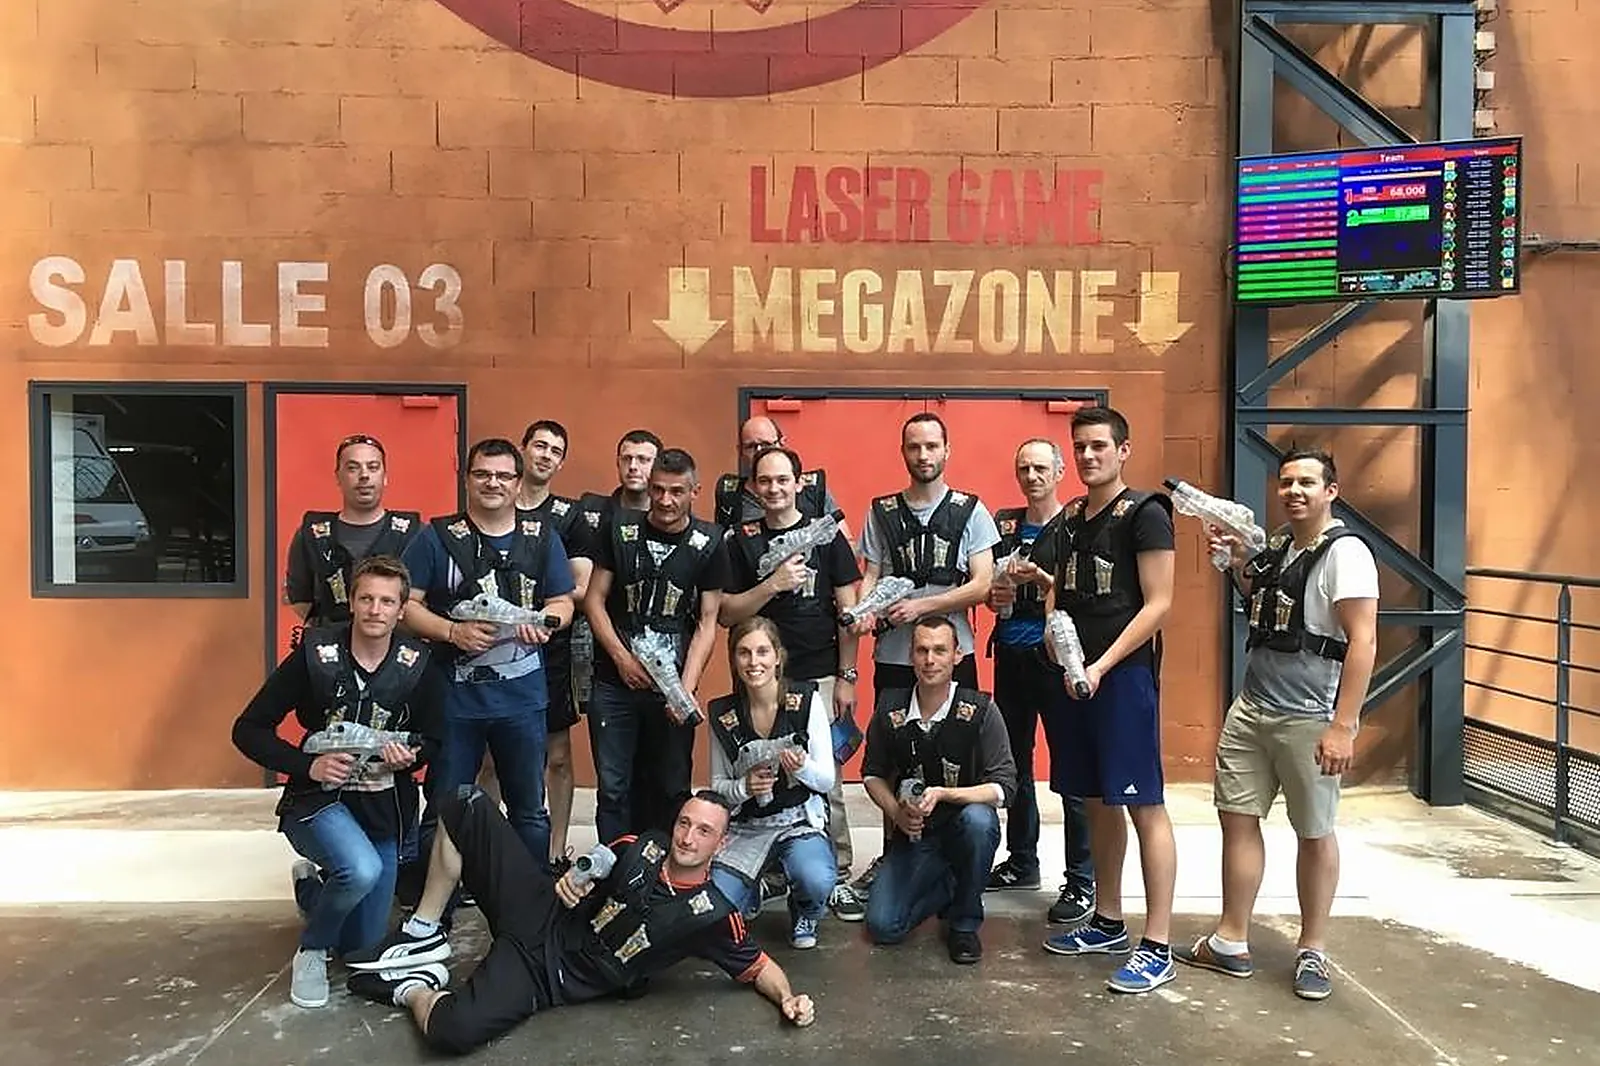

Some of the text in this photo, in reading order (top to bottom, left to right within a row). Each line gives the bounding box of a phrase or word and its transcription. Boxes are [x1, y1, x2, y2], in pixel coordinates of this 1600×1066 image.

[1380, 154, 1405, 163] Team
[750, 165, 1105, 246] LASER GAME
[28, 256, 464, 349] SALLE 03
[732, 265, 1118, 354] MEGAZONE
